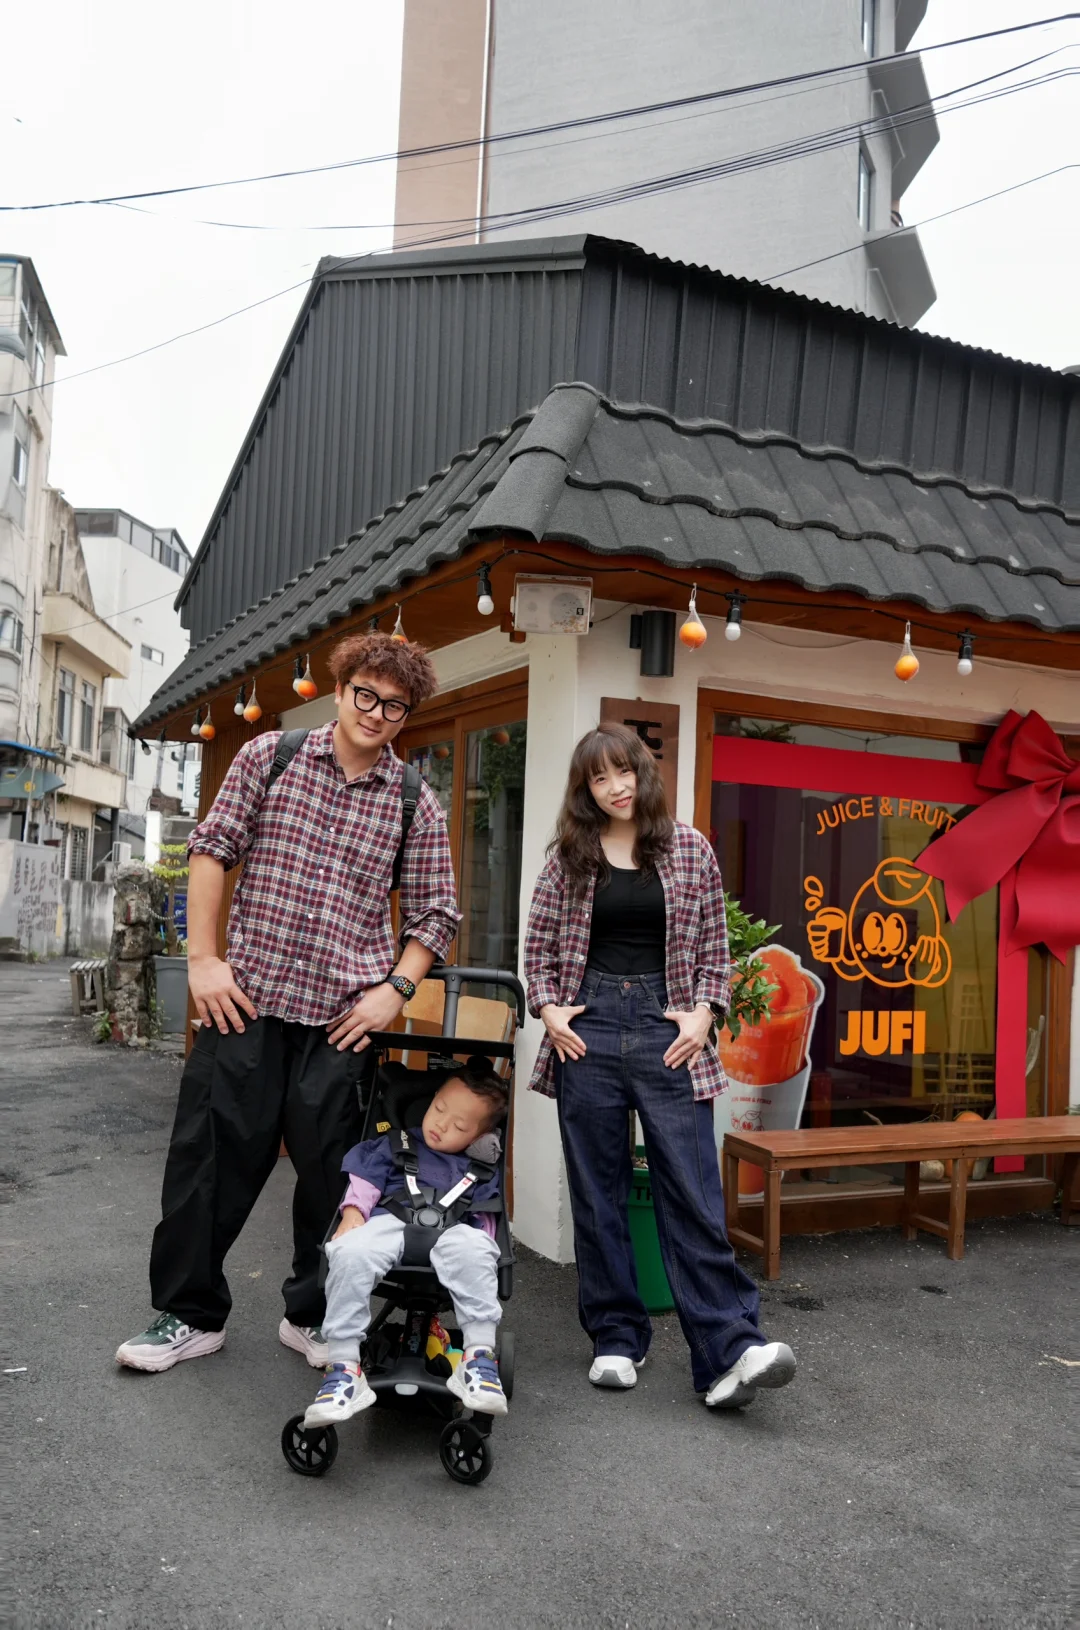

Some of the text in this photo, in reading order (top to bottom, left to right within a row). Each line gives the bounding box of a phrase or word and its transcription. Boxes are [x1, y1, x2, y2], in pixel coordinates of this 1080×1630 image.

[816, 796, 957, 835] JUICE & FRUIT
[839, 1010, 926, 1055] JUFI
